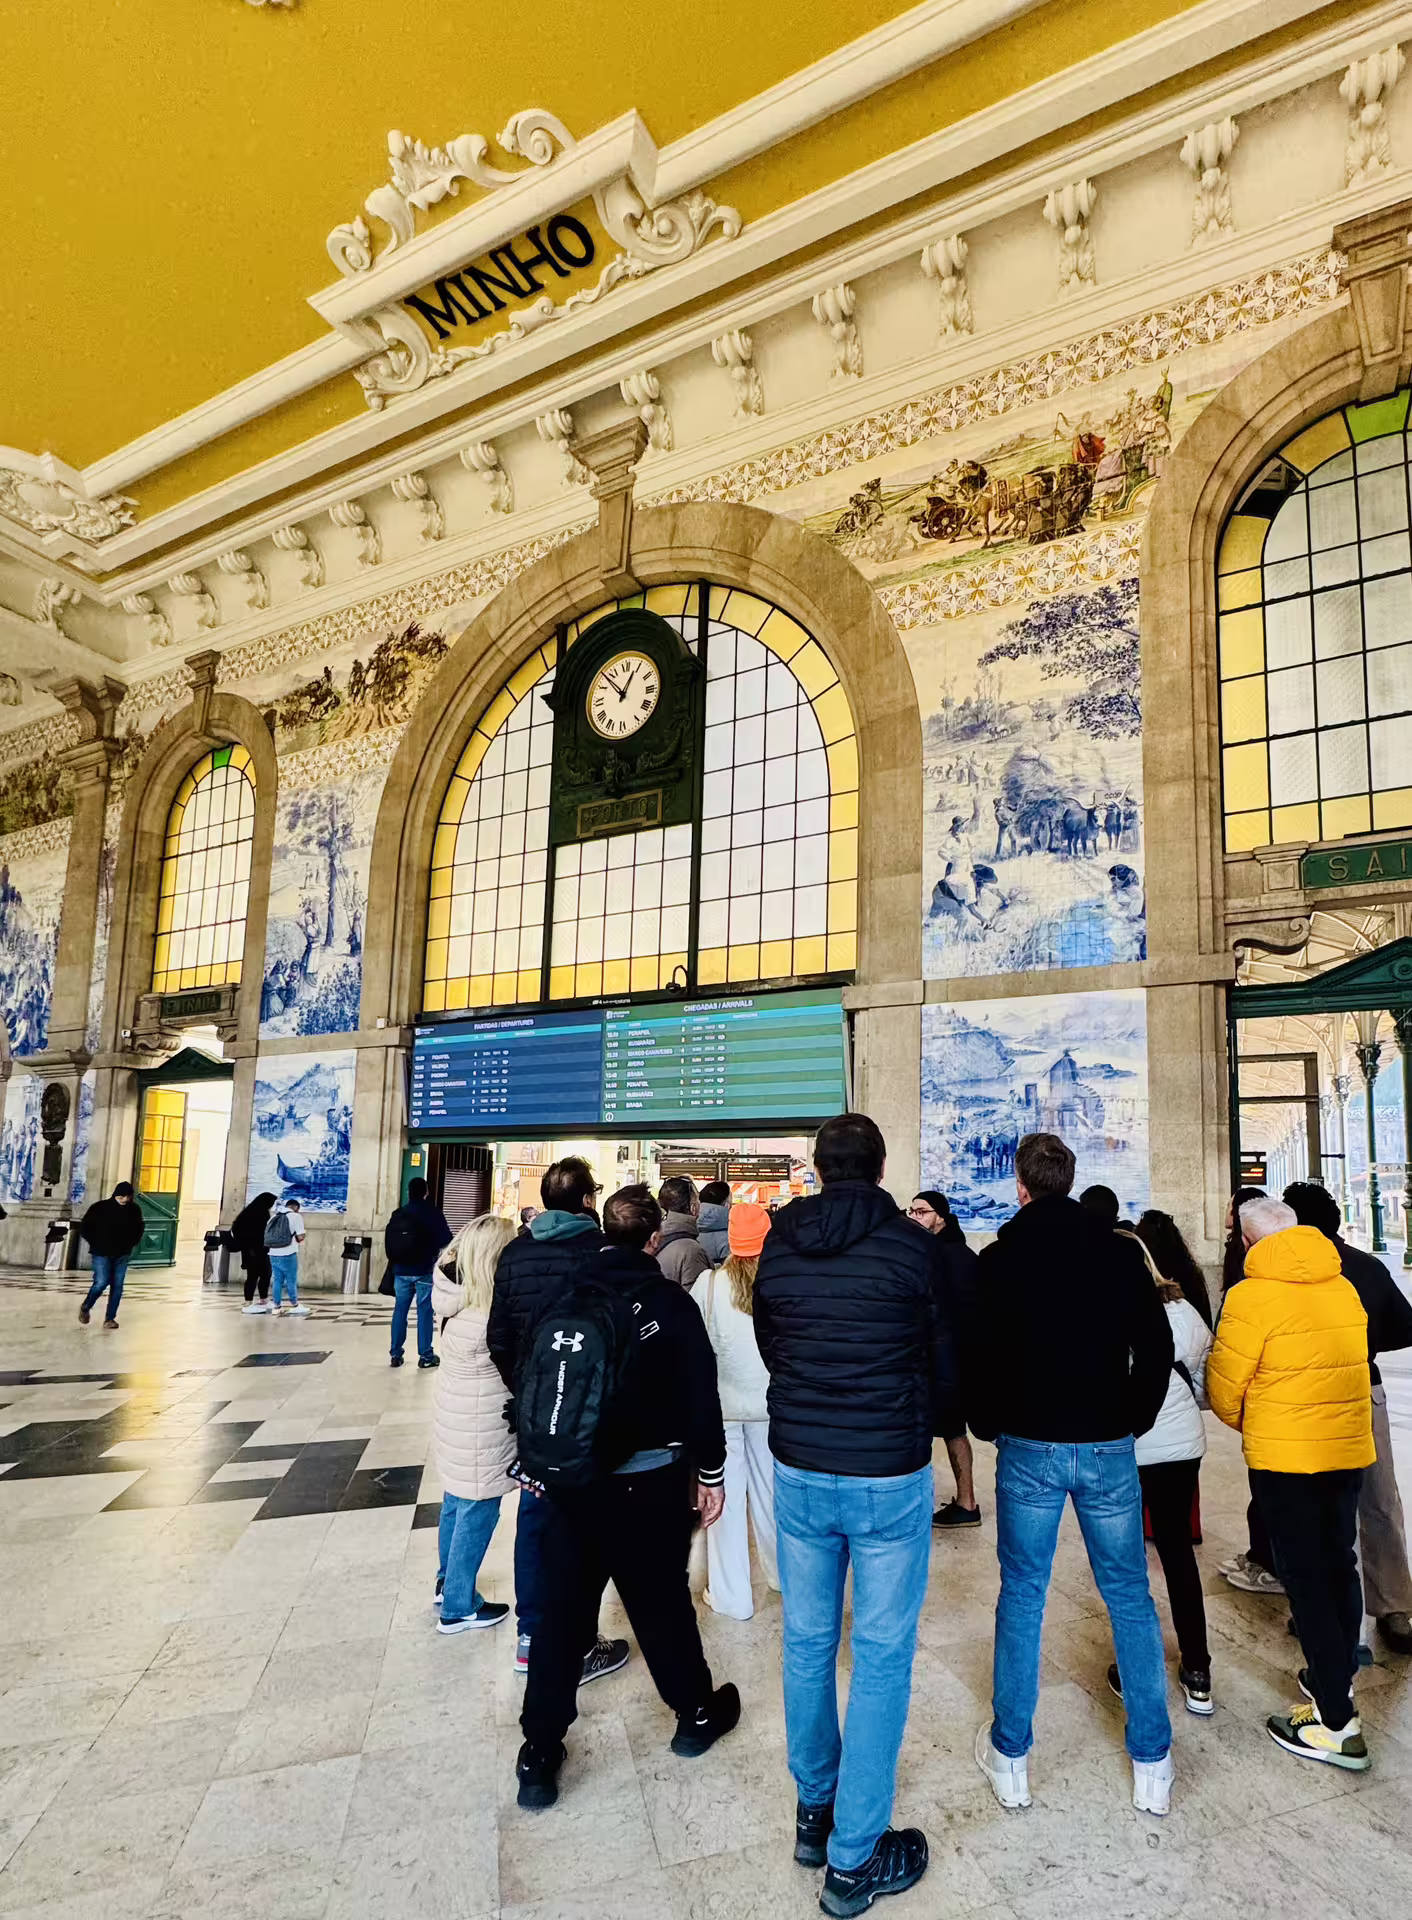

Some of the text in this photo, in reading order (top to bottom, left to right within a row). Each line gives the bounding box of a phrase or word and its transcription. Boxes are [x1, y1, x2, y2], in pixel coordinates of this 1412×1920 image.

[404, 215, 595, 340] MINHO
[591, 797, 648, 823] PORTO
[1328, 847, 1406, 881] SAI
[683, 1002, 717, 1012] CHEGADAS
[721, 1000, 753, 1009] ARRIVALS
[474, 1021, 498, 1030] PARTIDAS
[501, 1018, 534, 1028] DEPARTURES
[549, 1360, 567, 1435] UNDER ARMOUR
